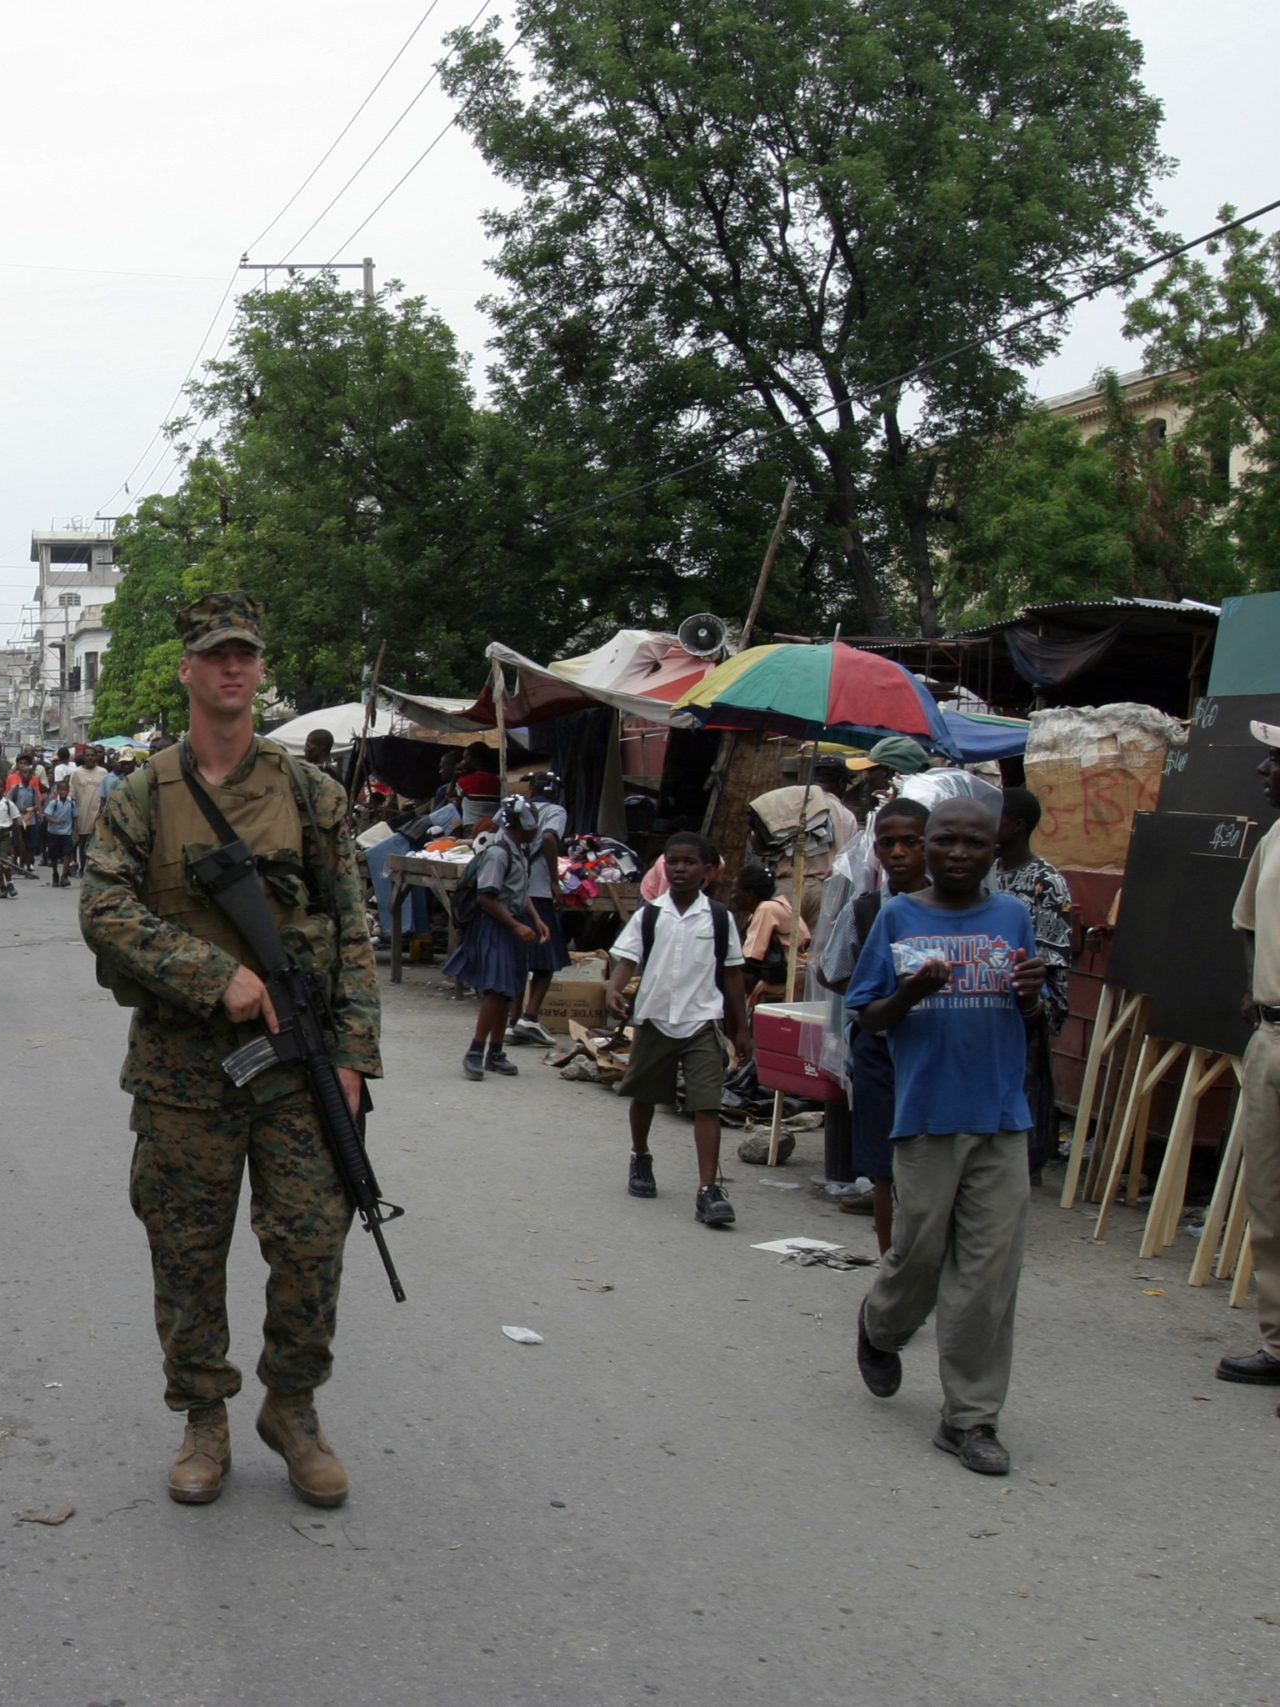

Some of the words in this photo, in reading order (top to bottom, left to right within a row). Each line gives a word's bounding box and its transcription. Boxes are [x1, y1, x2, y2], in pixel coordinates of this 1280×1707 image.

[1209, 822, 1241, 850] $30
[900, 934, 989, 962] ORONTO
[948, 997, 980, 1008] LEAGUE
